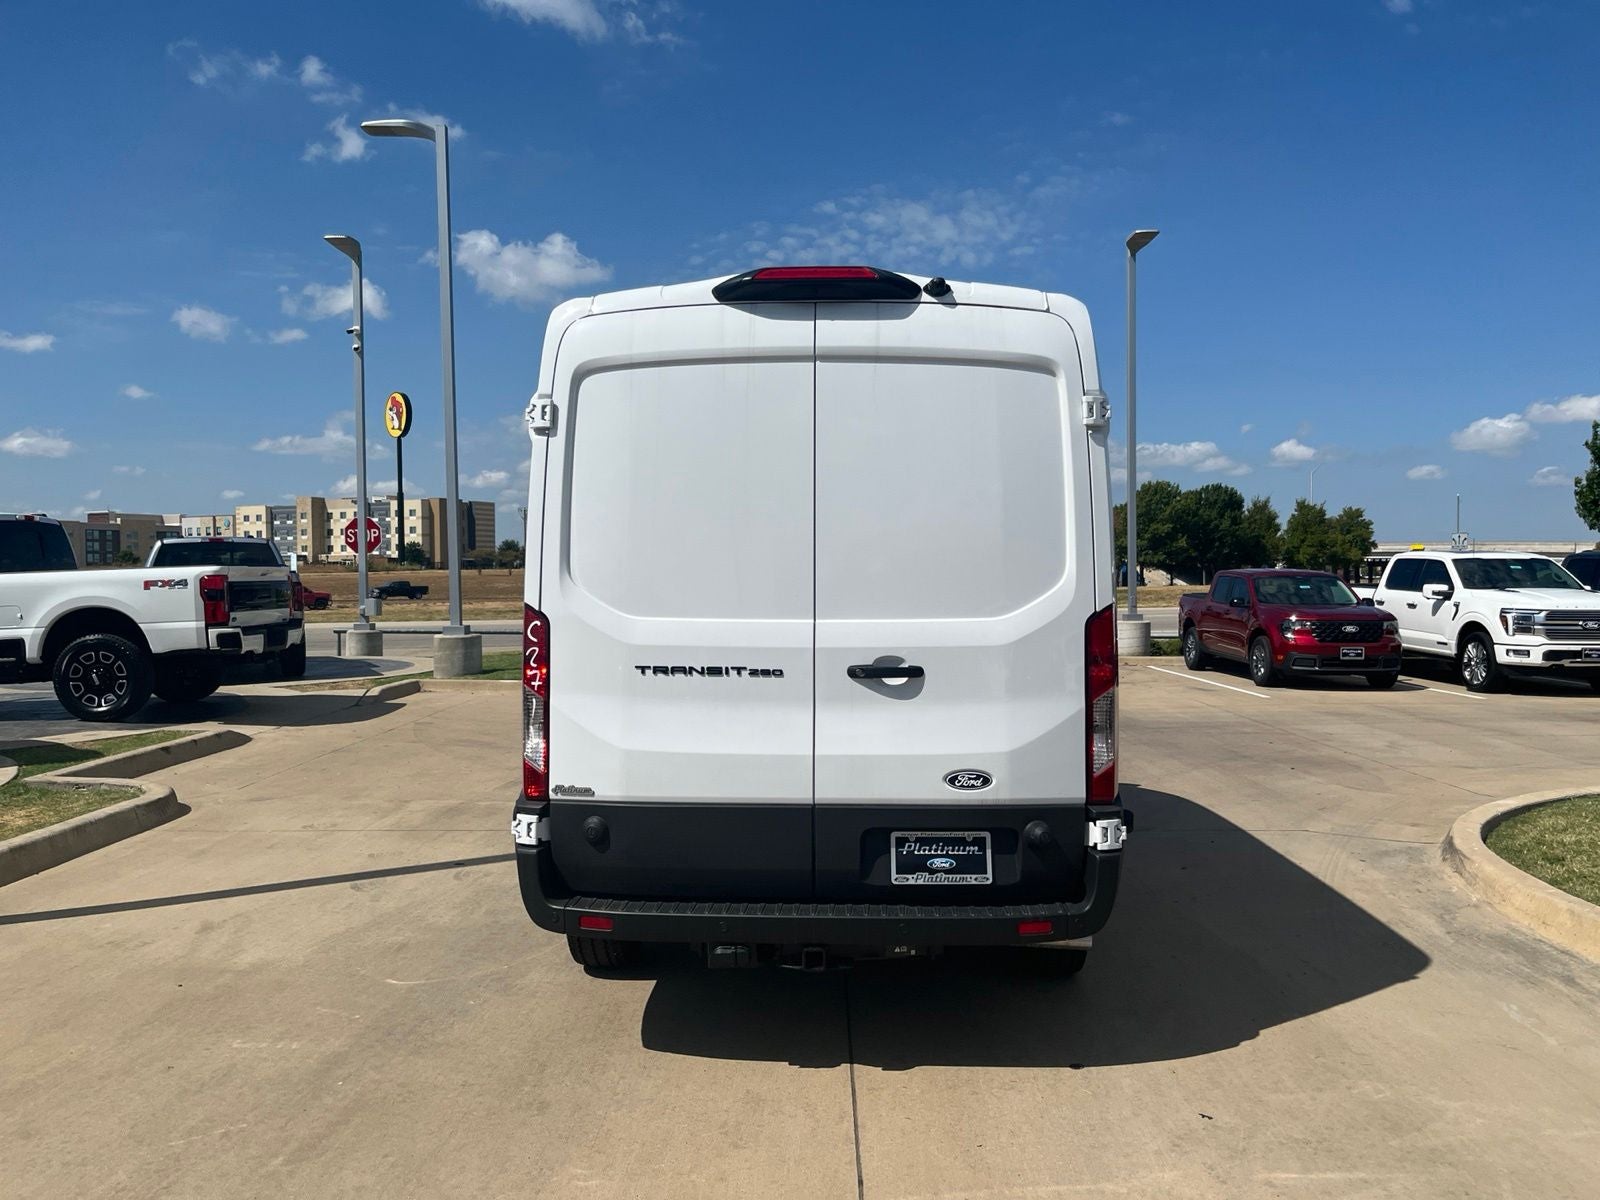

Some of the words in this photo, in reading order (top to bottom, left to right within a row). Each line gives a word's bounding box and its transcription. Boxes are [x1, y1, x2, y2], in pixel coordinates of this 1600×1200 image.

[346, 528, 379, 543] SP
[143, 579, 188, 590] FX4
[635, 665, 747, 677] TRANSIT
[898, 842, 983, 855] Platinum
[915, 873, 972, 883] Platinum
